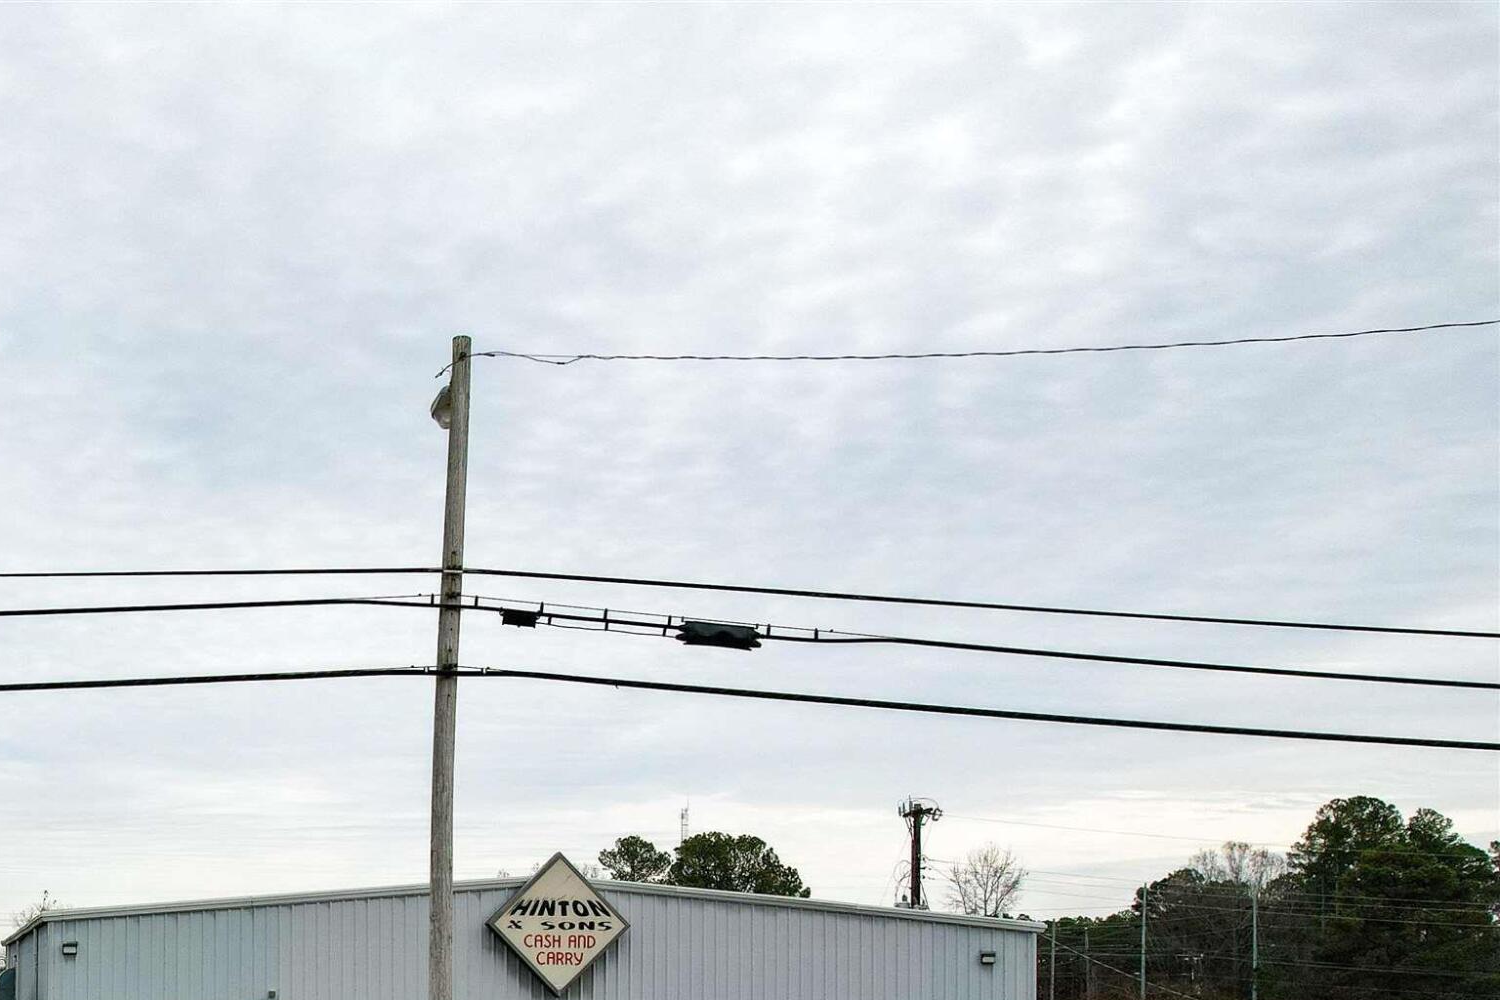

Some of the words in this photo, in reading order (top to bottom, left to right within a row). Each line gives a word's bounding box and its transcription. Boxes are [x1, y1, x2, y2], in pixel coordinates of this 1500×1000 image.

[510, 900, 611, 918] HINTON
[540, 921, 612, 931] SONS
[523, 934, 561, 948] CASH
[568, 934, 596, 949] AND
[536, 951, 583, 966] CARRY
